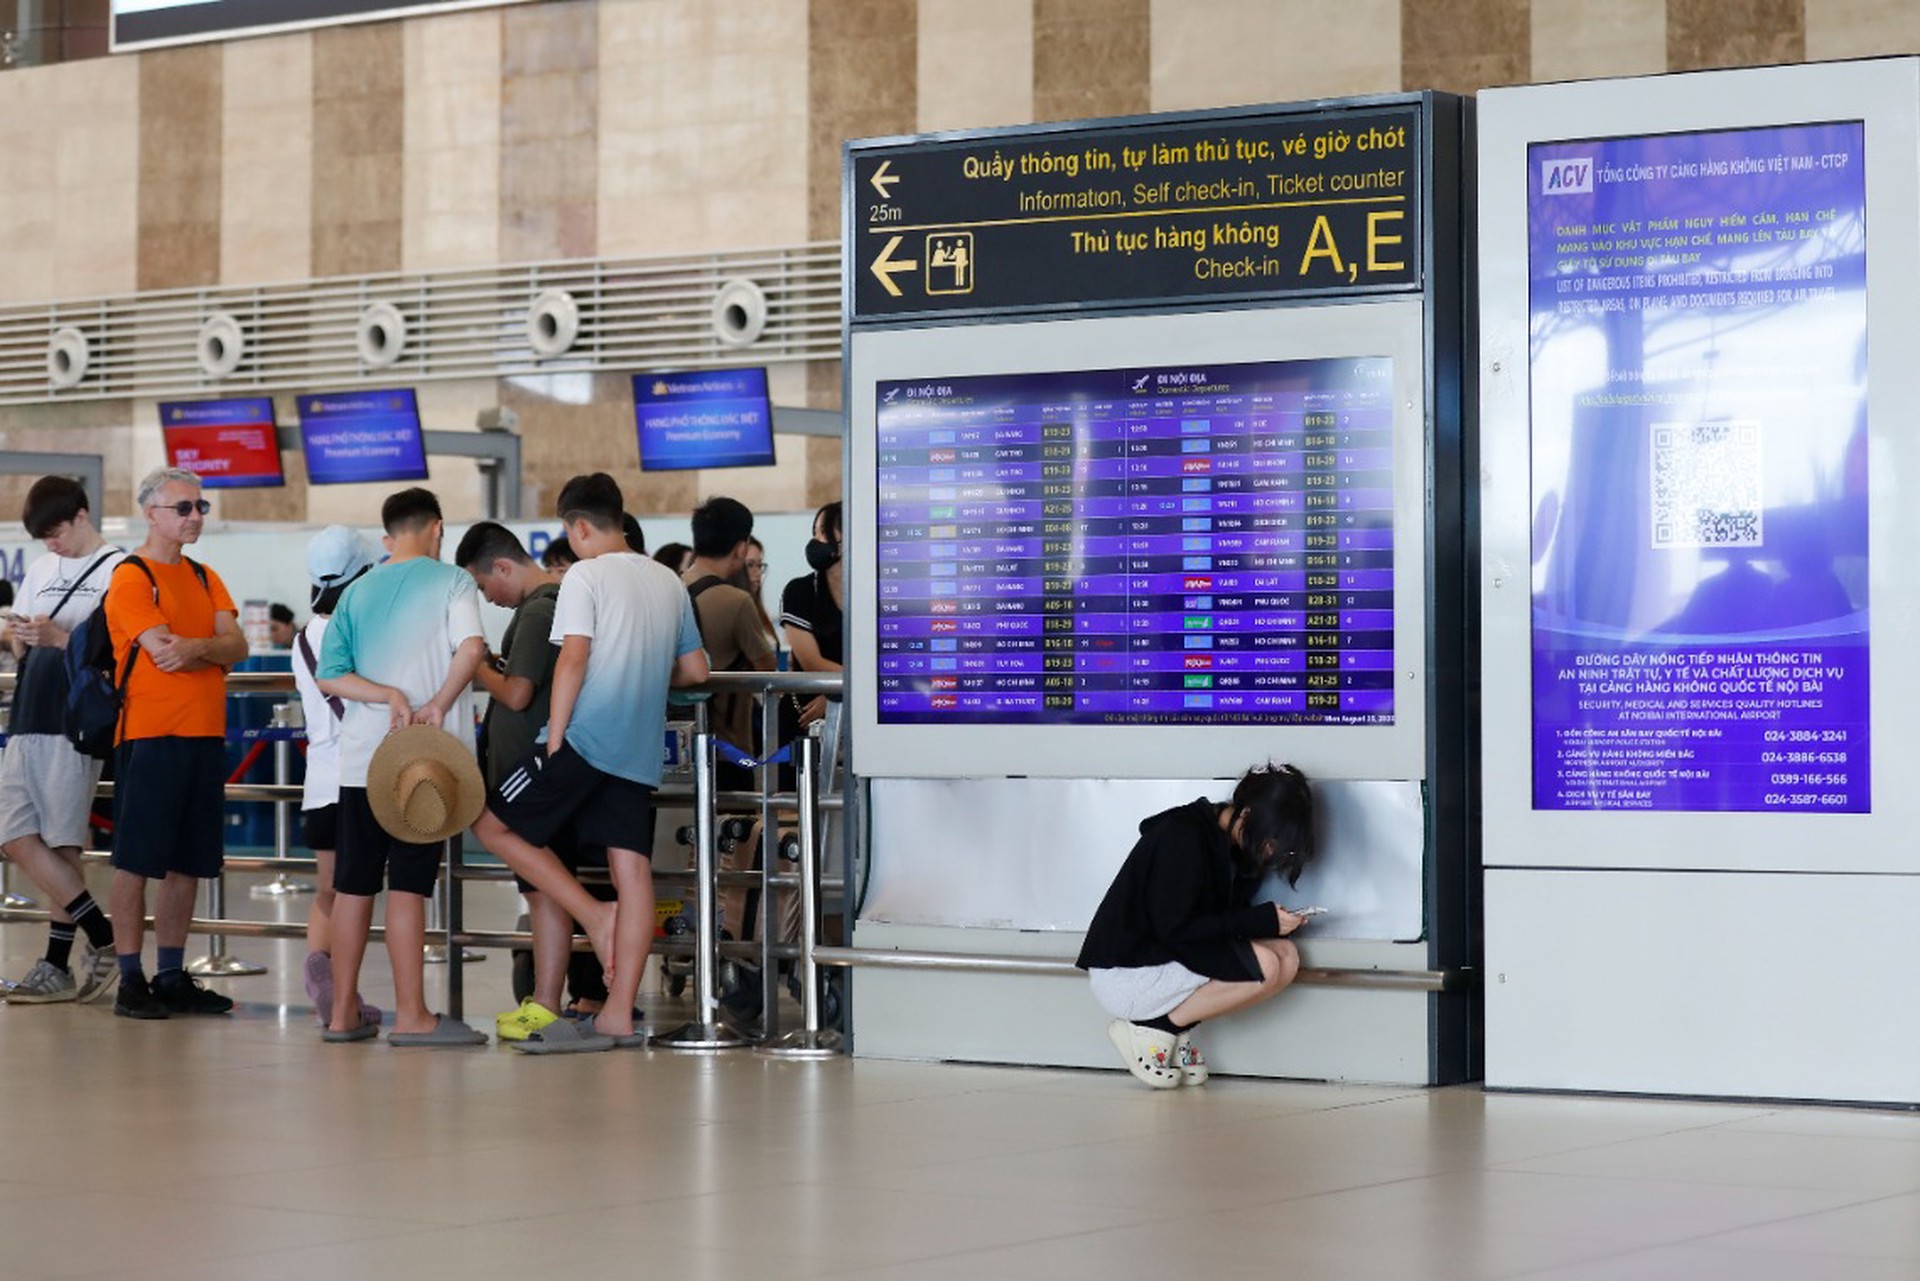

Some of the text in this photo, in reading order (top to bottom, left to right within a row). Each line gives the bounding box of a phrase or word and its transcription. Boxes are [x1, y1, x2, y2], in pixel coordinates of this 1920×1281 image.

[964, 126, 1405, 181] Quầy thông tin, tự làm thủ tục, vé giờ chót
[1626, 163, 1654, 181] CÔNG
[1657, 165, 1668, 179] TY
[1700, 158, 1728, 176] HÀNG
[1730, 156, 1765, 174] KHÔNG
[1768, 154, 1789, 174] VIỆT
[1791, 155, 1813, 170] NAM
[1821, 153, 1848, 169] CTCP
[1548, 164, 1588, 189] ACV
[1020, 168, 1405, 212] Information, Self check-in, Ticket counter
[870, 204, 902, 222] 25m
[1557, 226, 1587, 237] DANH
[1685, 218, 1714, 229] NGUY
[1071, 221, 1280, 256] Thủ tục hàng không
[1557, 242, 1588, 253] MANG
[1616, 239, 1637, 250] KHU
[1717, 232, 1749, 244] MANG
[1752, 229, 1772, 242] LÊN
[1195, 256, 1280, 280] Check-in
[1557, 279, 1572, 293] LIST
[1574, 279, 1584, 292] OF
[1169, 372, 1188, 385] NỘI
[918, 385, 935, 398] NỘI
[1576, 653, 1620, 666] ĐƯỜNG
[1622, 652, 1648, 666] DÂY
[1688, 650, 1715, 665] TIẾP
[1718, 652, 1753, 666] NHẬN
[1755, 651, 1799, 664] THÔNG
[1801, 653, 1822, 664] TIN
[1559, 669, 1576, 680] AN
[1578, 668, 1609, 680] NINH
[1611, 667, 1641, 681] TRẬT
[1664, 668, 1673, 679] Y
[1675, 666, 1690, 679] TẾ
[1692, 667, 1709, 679] VÀ
[1711, 664, 1744, 679] CHẤT
[1746, 667, 1789, 680] LƯỢNG
[1793, 667, 1823, 680] DỊCH
[1826, 667, 1844, 680] VỤ
[1579, 678, 1823, 695] TẠI CẢNG HÀNG KHÔNG QUỐC TẾ NỘI BÀI
[1625, 700, 1665, 709] MEDICAL
[1667, 700, 1688, 709] AND
[1690, 700, 1733, 709] SERVICES
[1735, 700, 1775, 710] QUALITY
[1777, 700, 1823, 708] HOTLINES
[1618, 711, 1629, 720] AT
[1666, 711, 1738, 720] INTERNATIONAL
[1741, 710, 1781, 720] AIRPORT
[1764, 731, 1847, 741] 024-3884-3241
[1761, 752, 1847, 763] 024-3886-6538
[1771, 774, 1847, 784] 0389-166-566
[1764, 794, 1847, 804] 024-3587-6601
